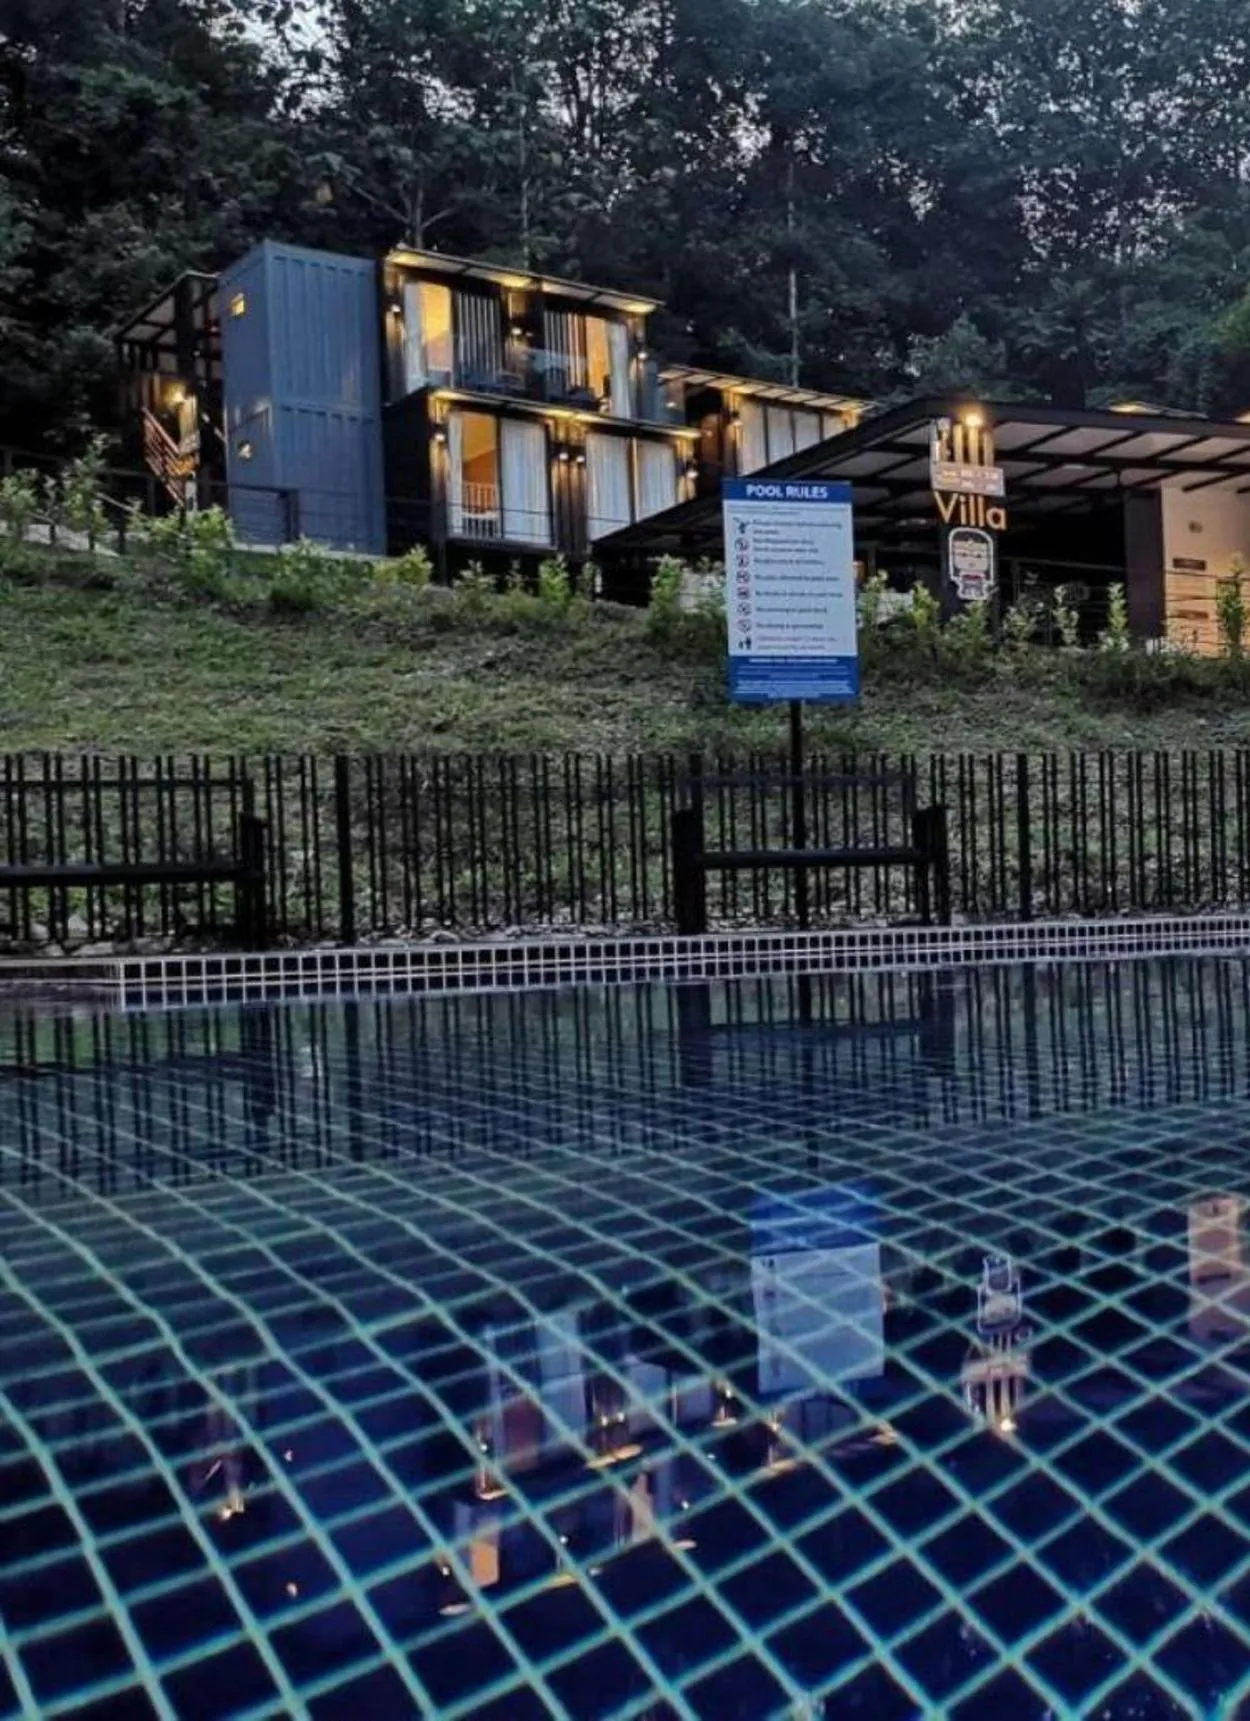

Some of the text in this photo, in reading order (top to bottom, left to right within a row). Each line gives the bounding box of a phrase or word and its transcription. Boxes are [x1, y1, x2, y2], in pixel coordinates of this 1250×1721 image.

[746, 484, 829, 499] POOL RULES
[934, 491, 1007, 531] Villa
